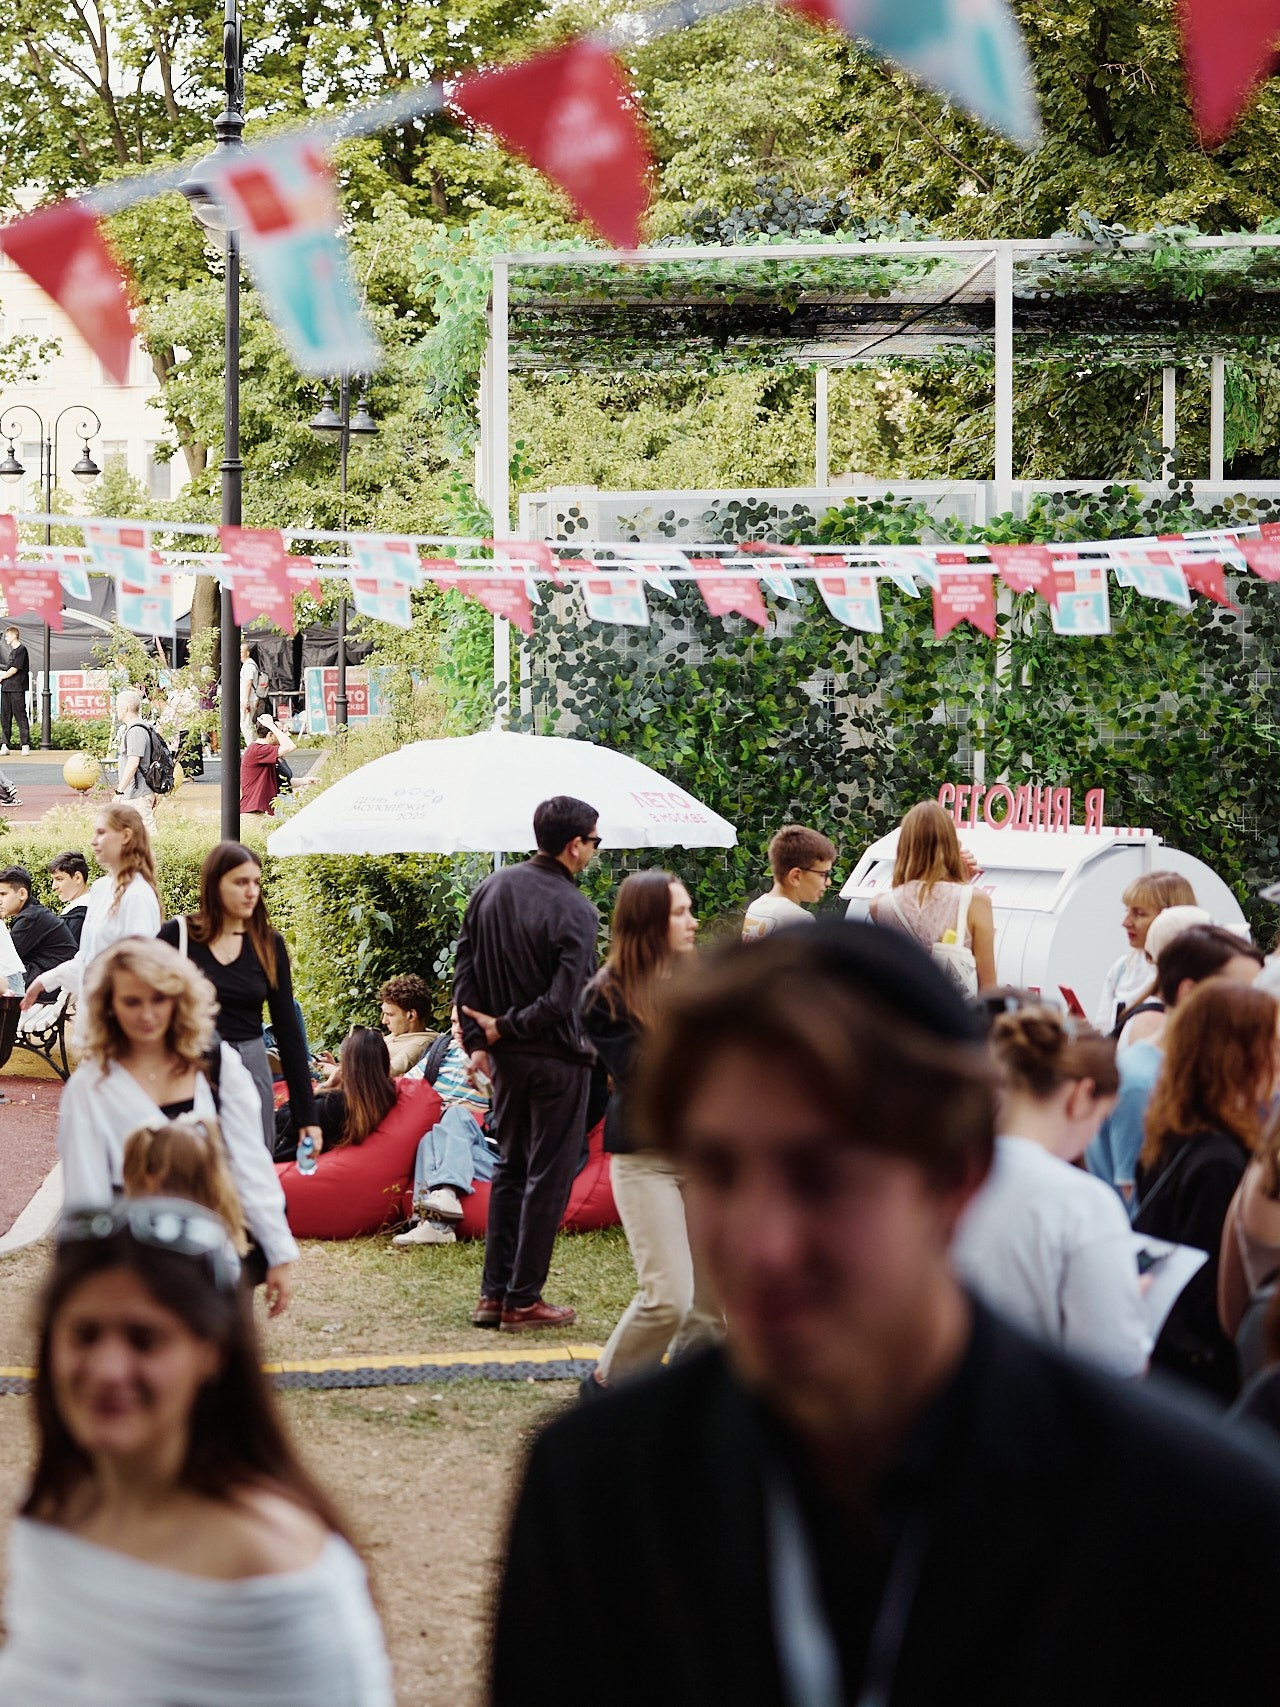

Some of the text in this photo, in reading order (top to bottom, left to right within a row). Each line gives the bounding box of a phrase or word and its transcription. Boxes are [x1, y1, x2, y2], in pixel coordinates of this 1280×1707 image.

[327, 689, 365, 703] ЛТО
[630, 791, 691, 809] ЛЕТО
[938, 782, 1072, 834] СЕГОДНЯ
[1084, 788, 1105, 835] Я
